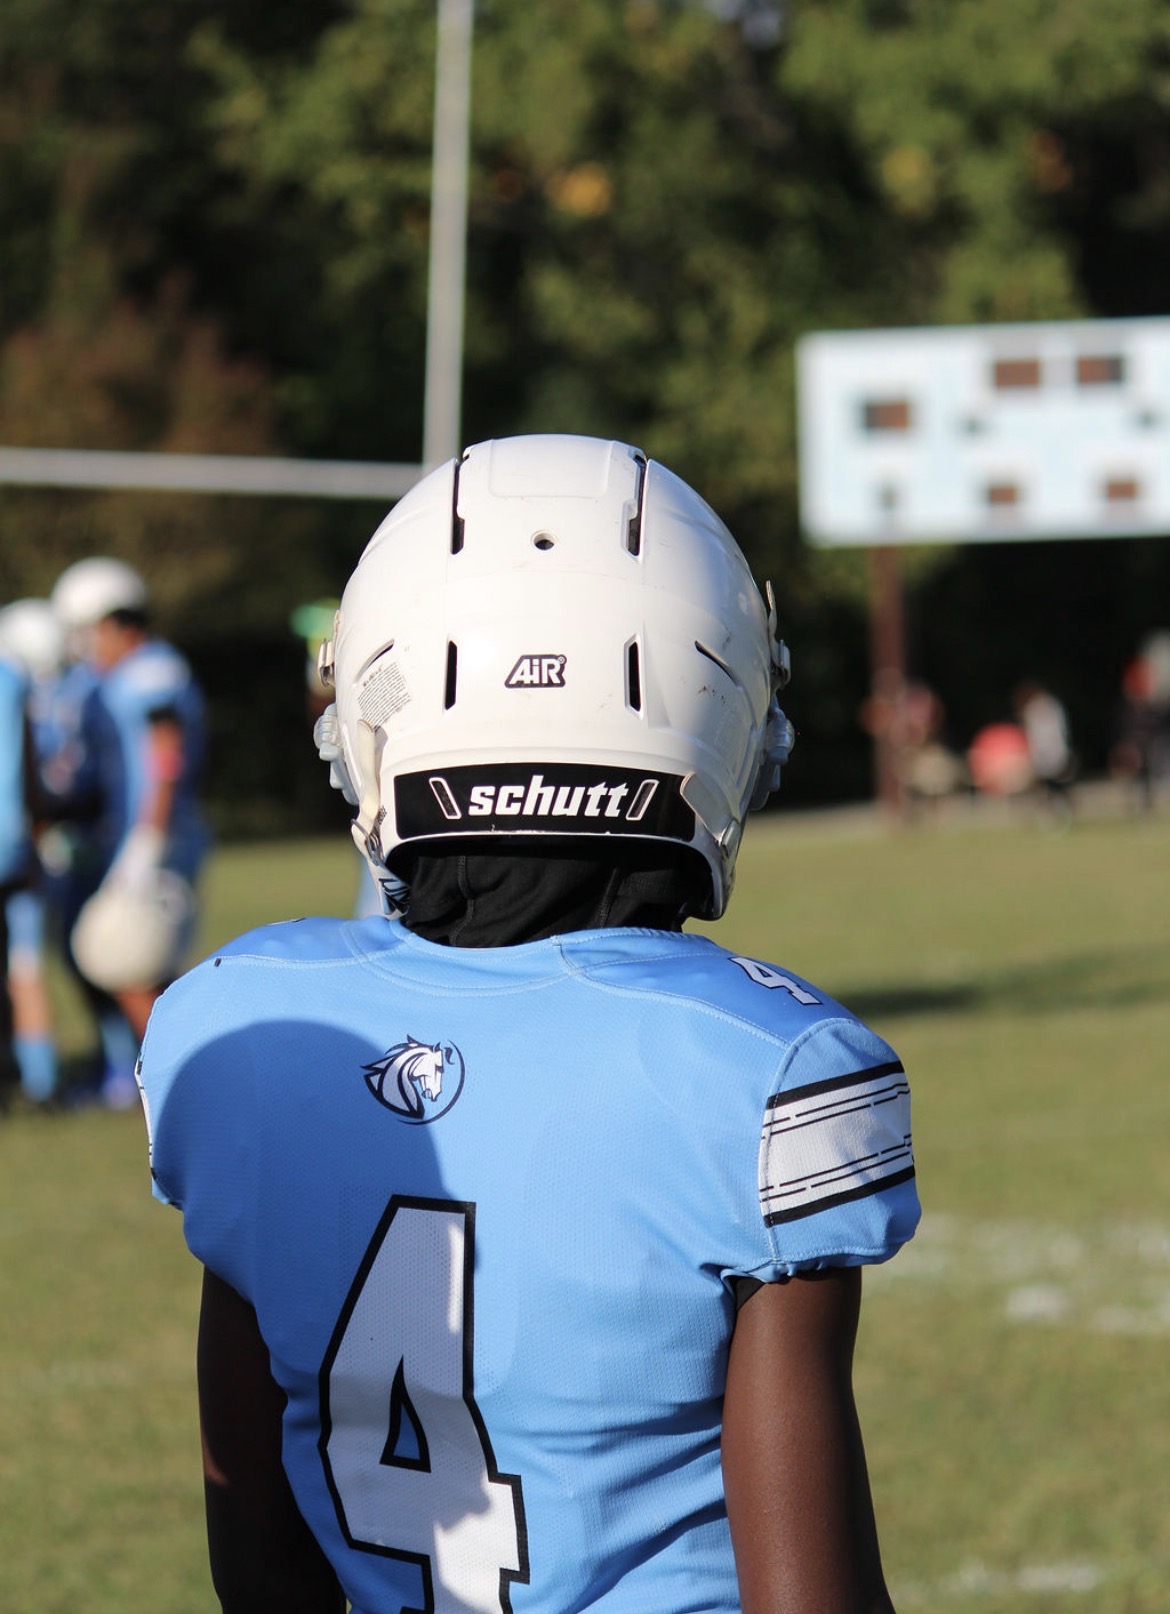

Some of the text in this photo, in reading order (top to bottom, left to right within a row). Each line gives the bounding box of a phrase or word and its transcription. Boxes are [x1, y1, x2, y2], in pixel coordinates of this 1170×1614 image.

[468, 775, 629, 818] schutt
[727, 955, 823, 1006] 4
[317, 1194, 531, 1614] 4
